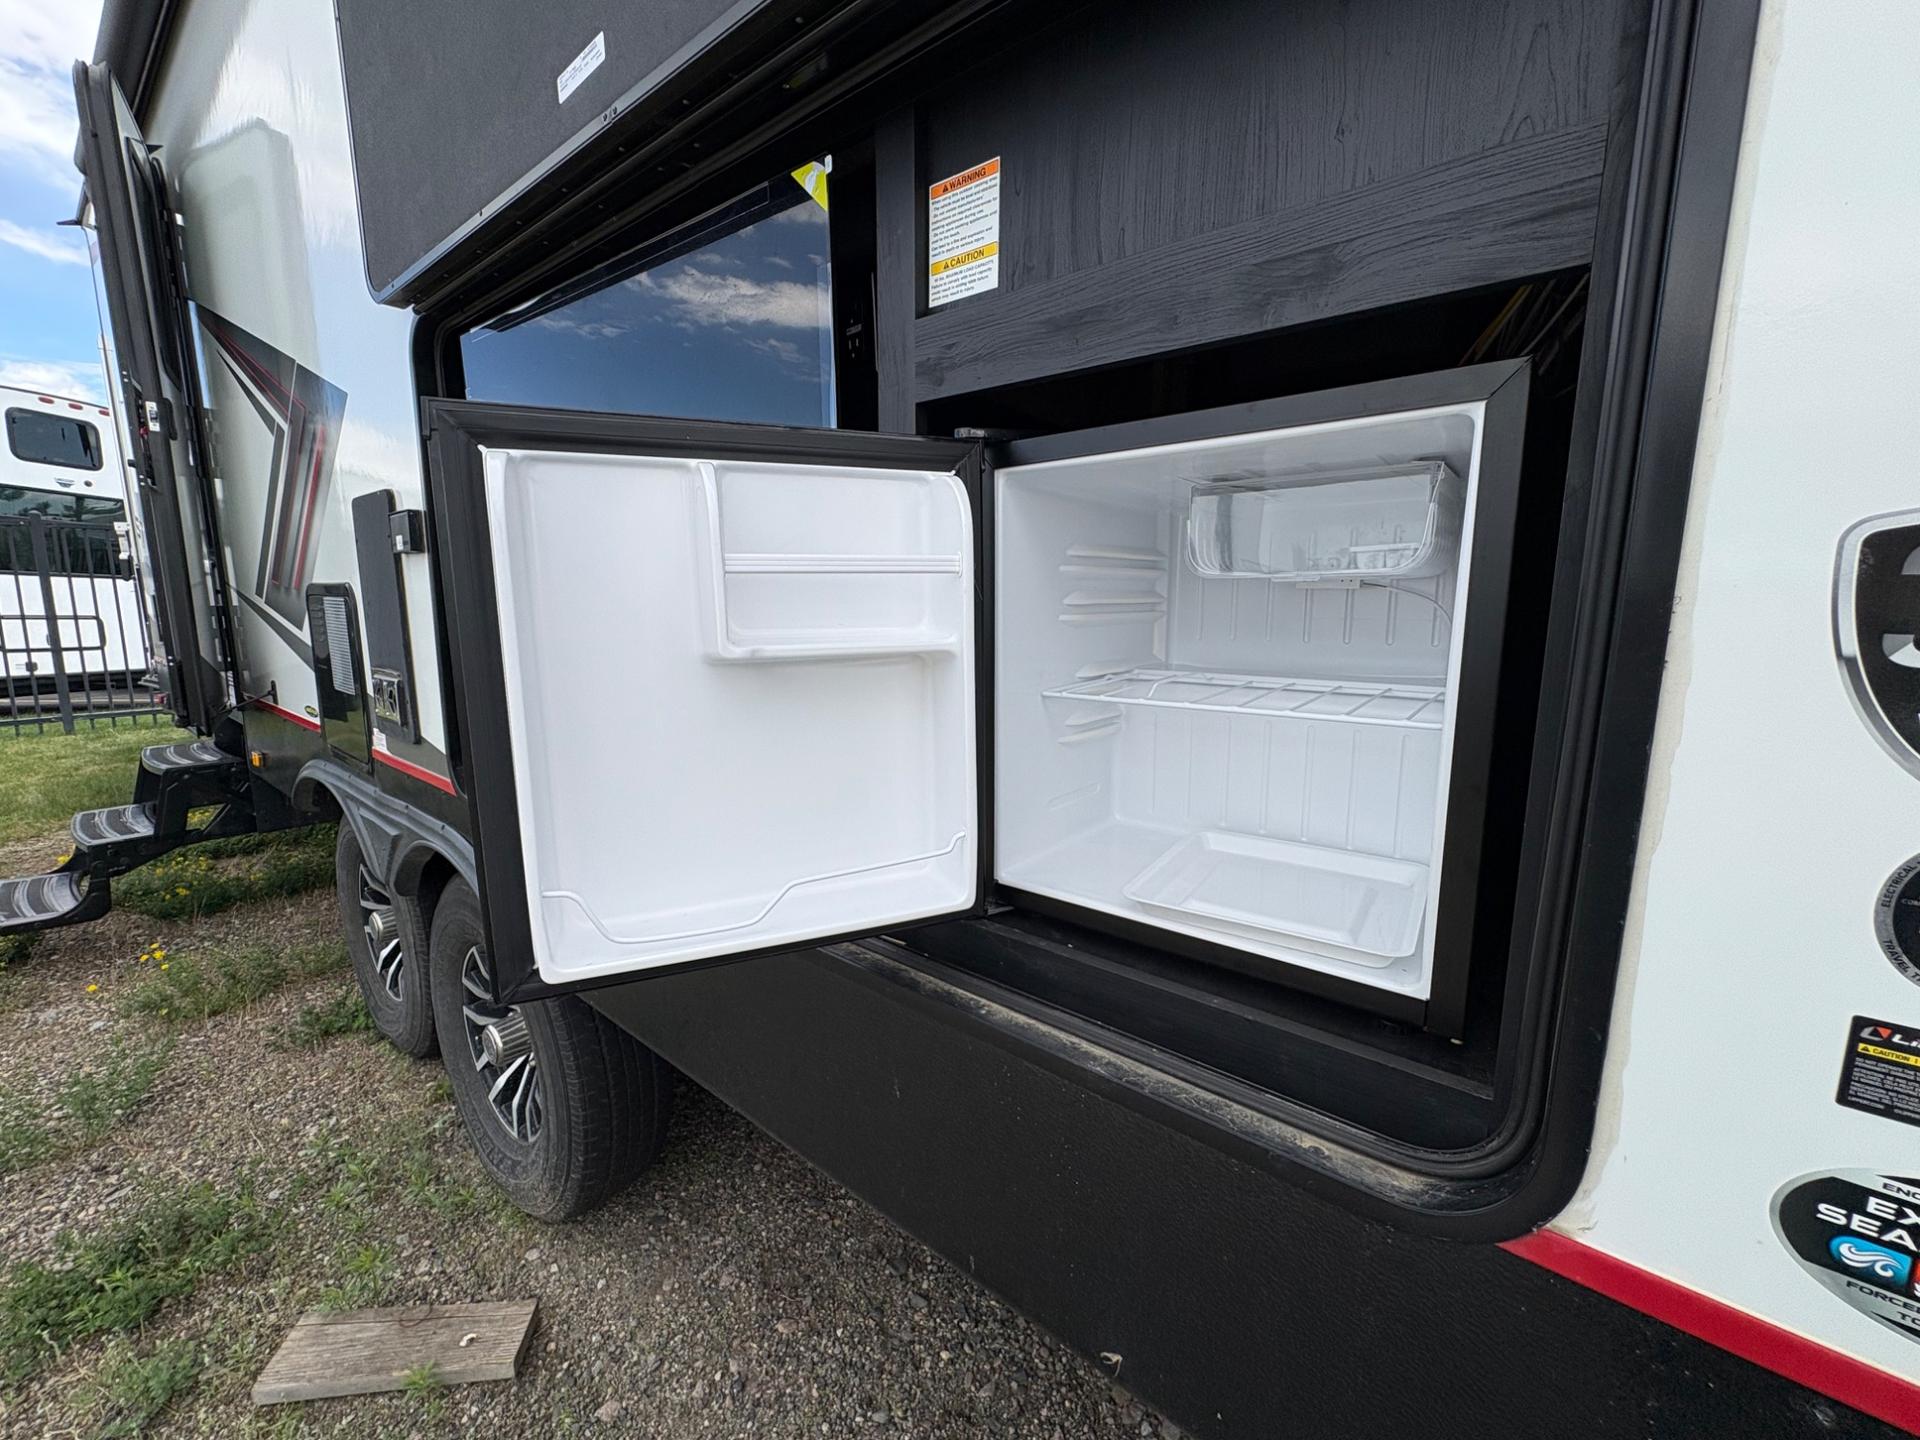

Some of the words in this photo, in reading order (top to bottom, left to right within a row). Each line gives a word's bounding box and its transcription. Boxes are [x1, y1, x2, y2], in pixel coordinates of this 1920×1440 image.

[949, 168, 986, 189] WARNING
[950, 249, 985, 267] CAUTION
[1881, 865, 1918, 908] ELECTRICAL
[1882, 940, 1911, 973] TRAVEL
[1873, 1048, 1911, 1062] CAUTION
[1846, 1281, 1920, 1314] FORCE
